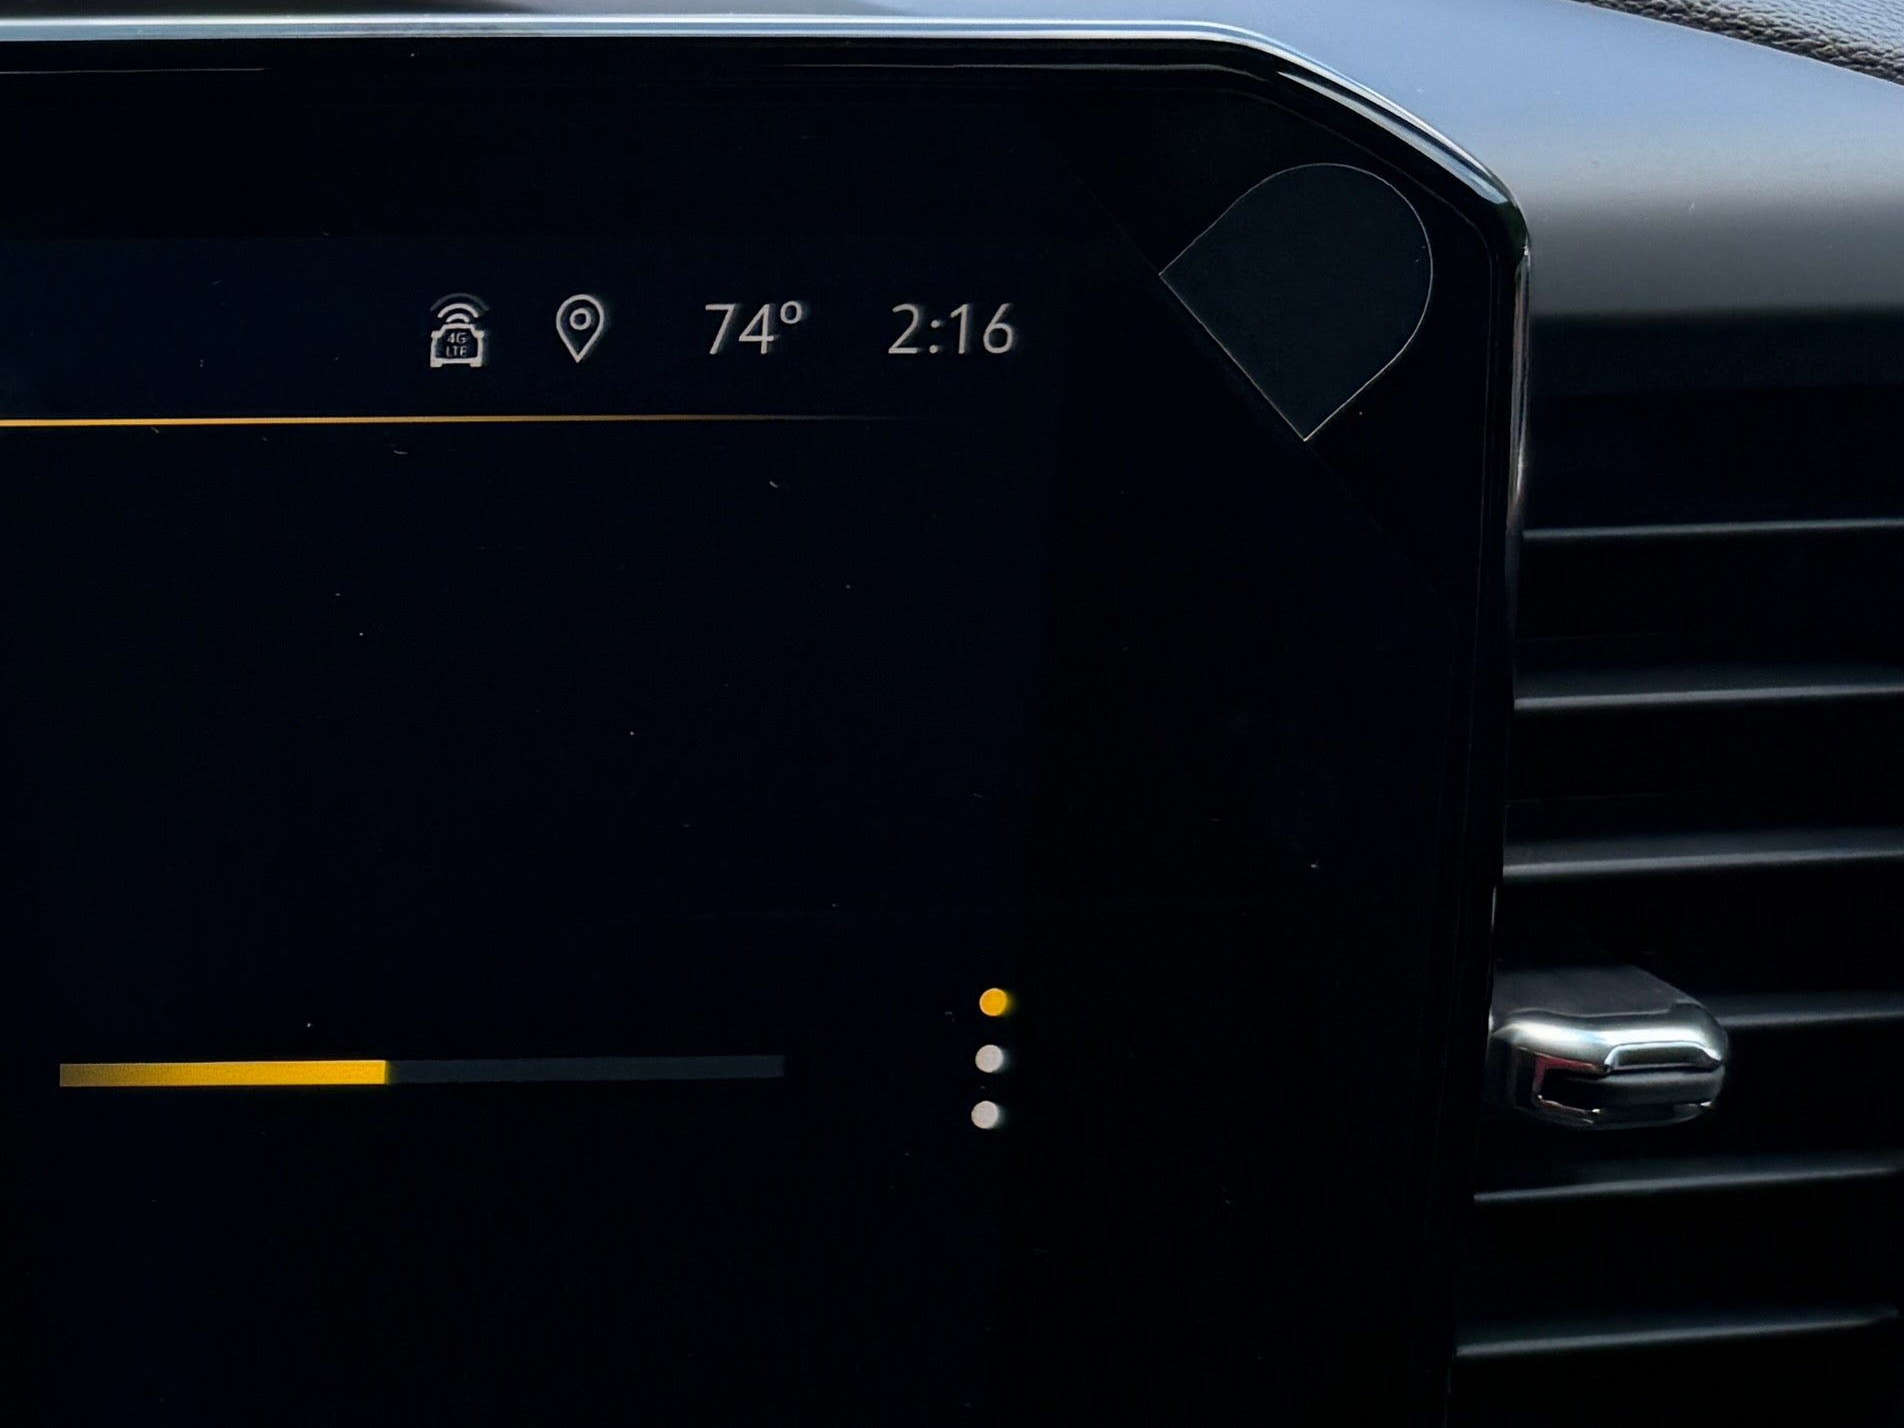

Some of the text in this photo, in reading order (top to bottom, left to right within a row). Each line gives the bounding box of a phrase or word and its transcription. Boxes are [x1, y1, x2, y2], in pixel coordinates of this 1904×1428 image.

[446, 332, 467, 344] 4G
[704, 300, 804, 355] 74°
[887, 303, 1014, 355] 2:16
[445, 345, 468, 357] LTE
